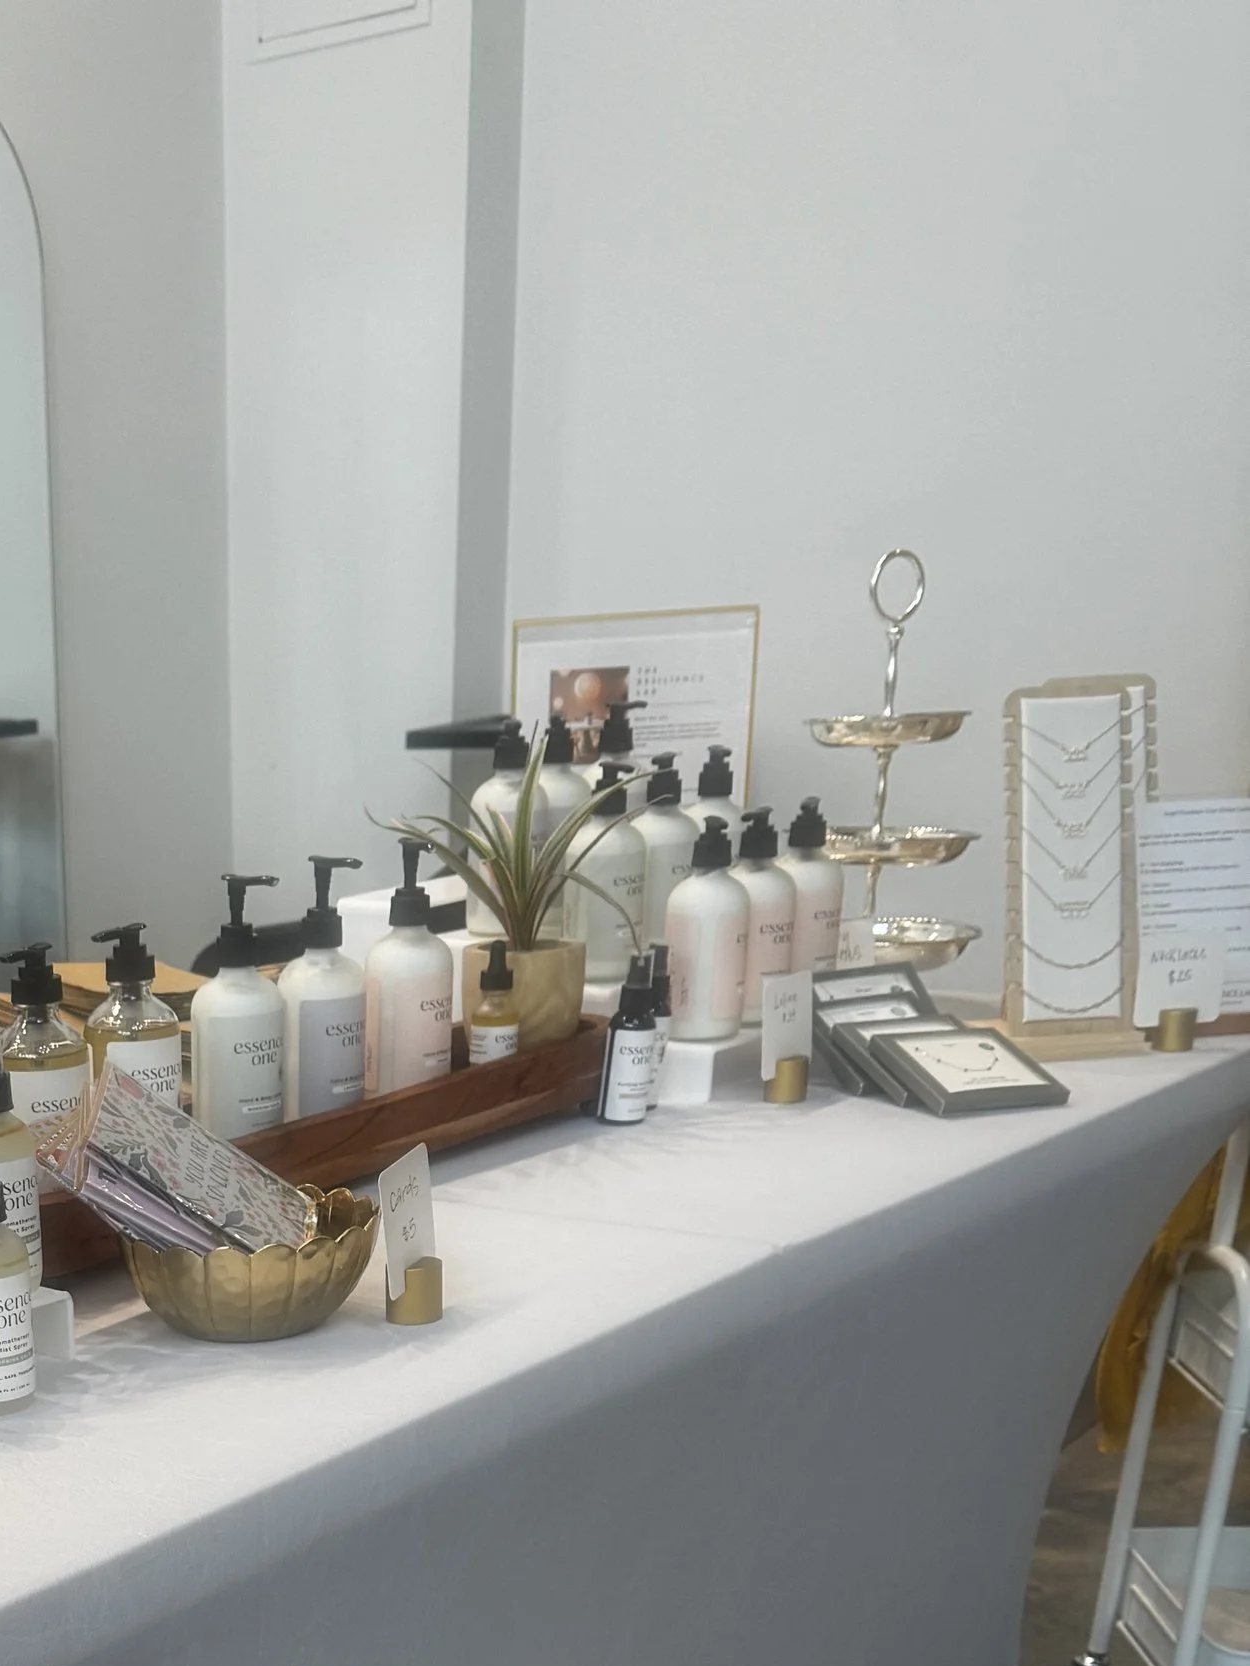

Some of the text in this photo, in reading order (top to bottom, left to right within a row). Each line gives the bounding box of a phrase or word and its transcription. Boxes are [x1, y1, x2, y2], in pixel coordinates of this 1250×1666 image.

[251, 1051, 277, 1066] one
[150, 1077, 175, 1093] one
[5, 1192, 33, 1212] one
[13, 1341, 28, 1352] Spray
